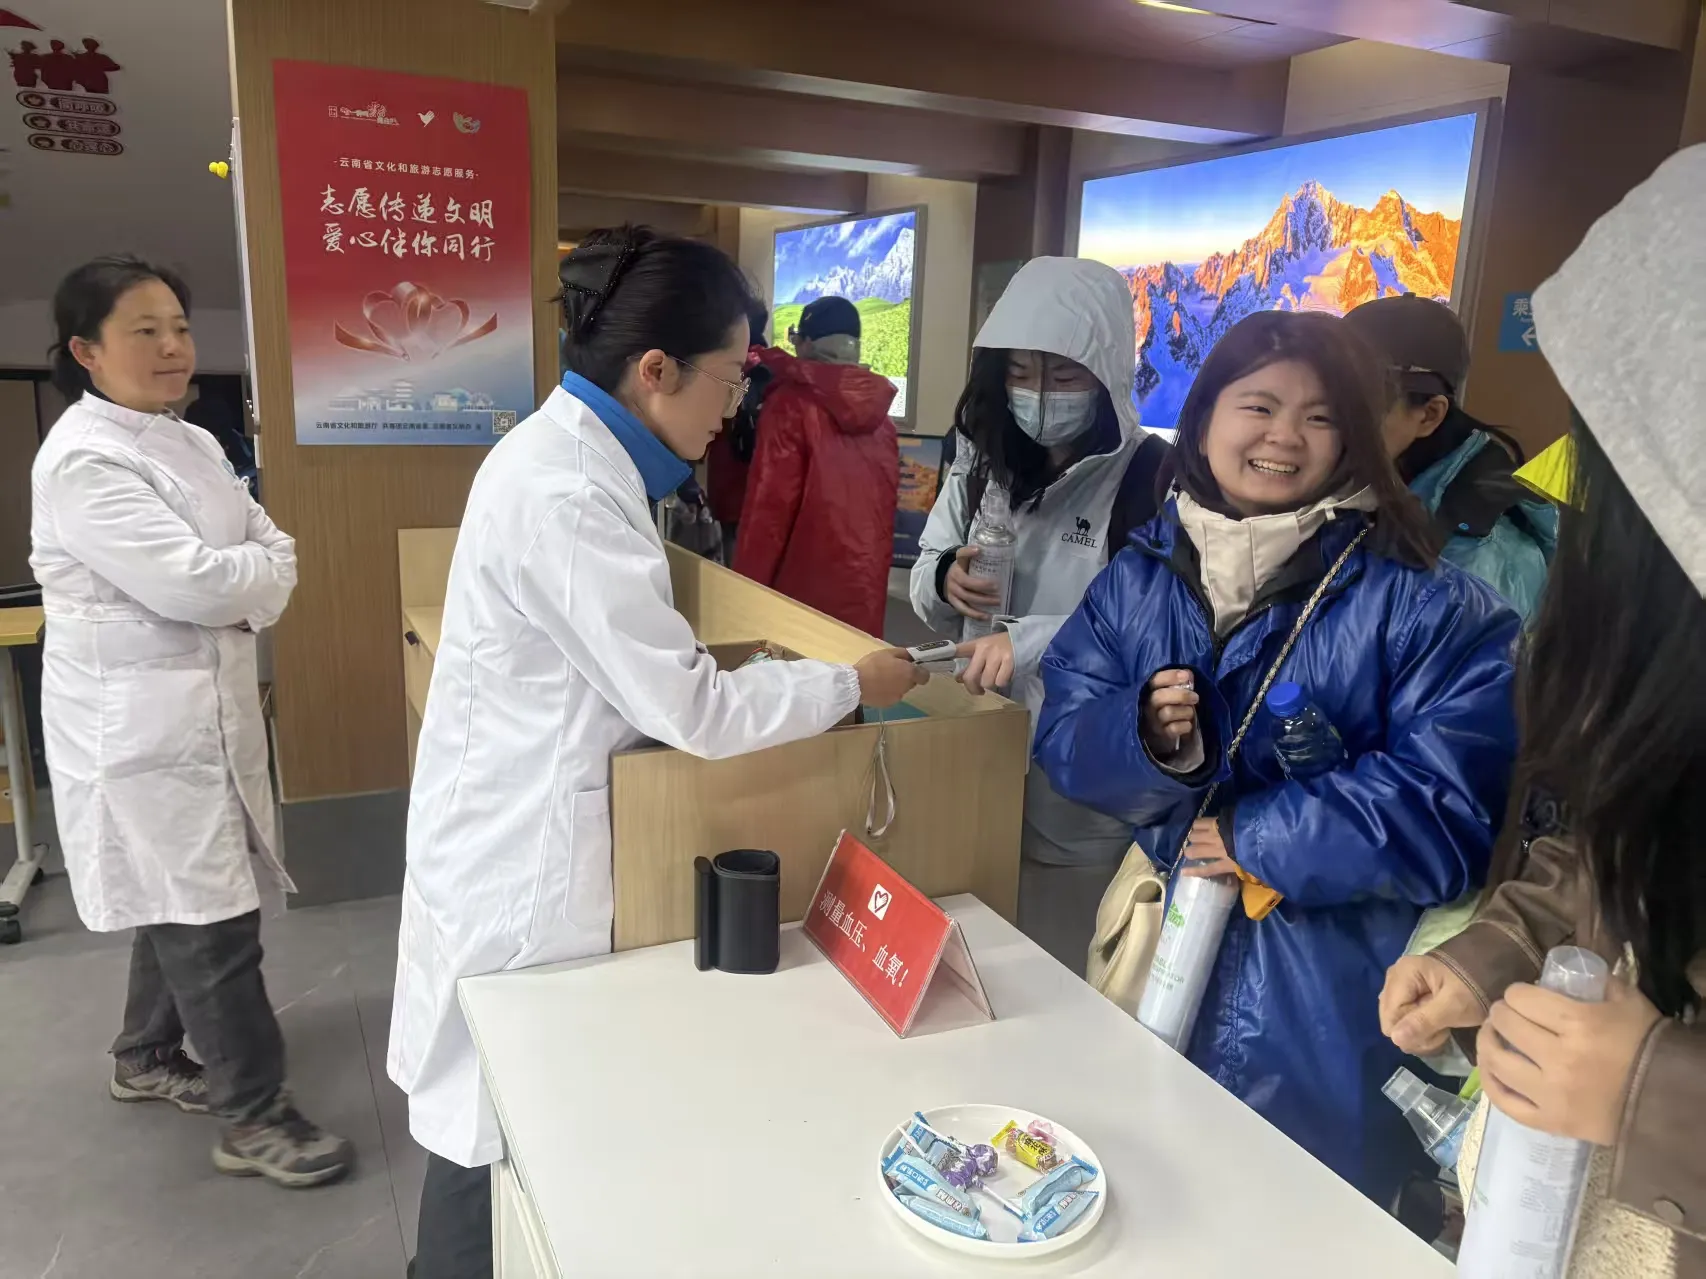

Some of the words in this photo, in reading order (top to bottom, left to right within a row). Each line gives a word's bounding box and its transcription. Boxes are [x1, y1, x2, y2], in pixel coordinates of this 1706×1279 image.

[320, 184, 495, 229] 志愿传递文明
[322, 222, 496, 262] 爱心伴你同行
[1061, 533, 1097, 548] CAMEL
